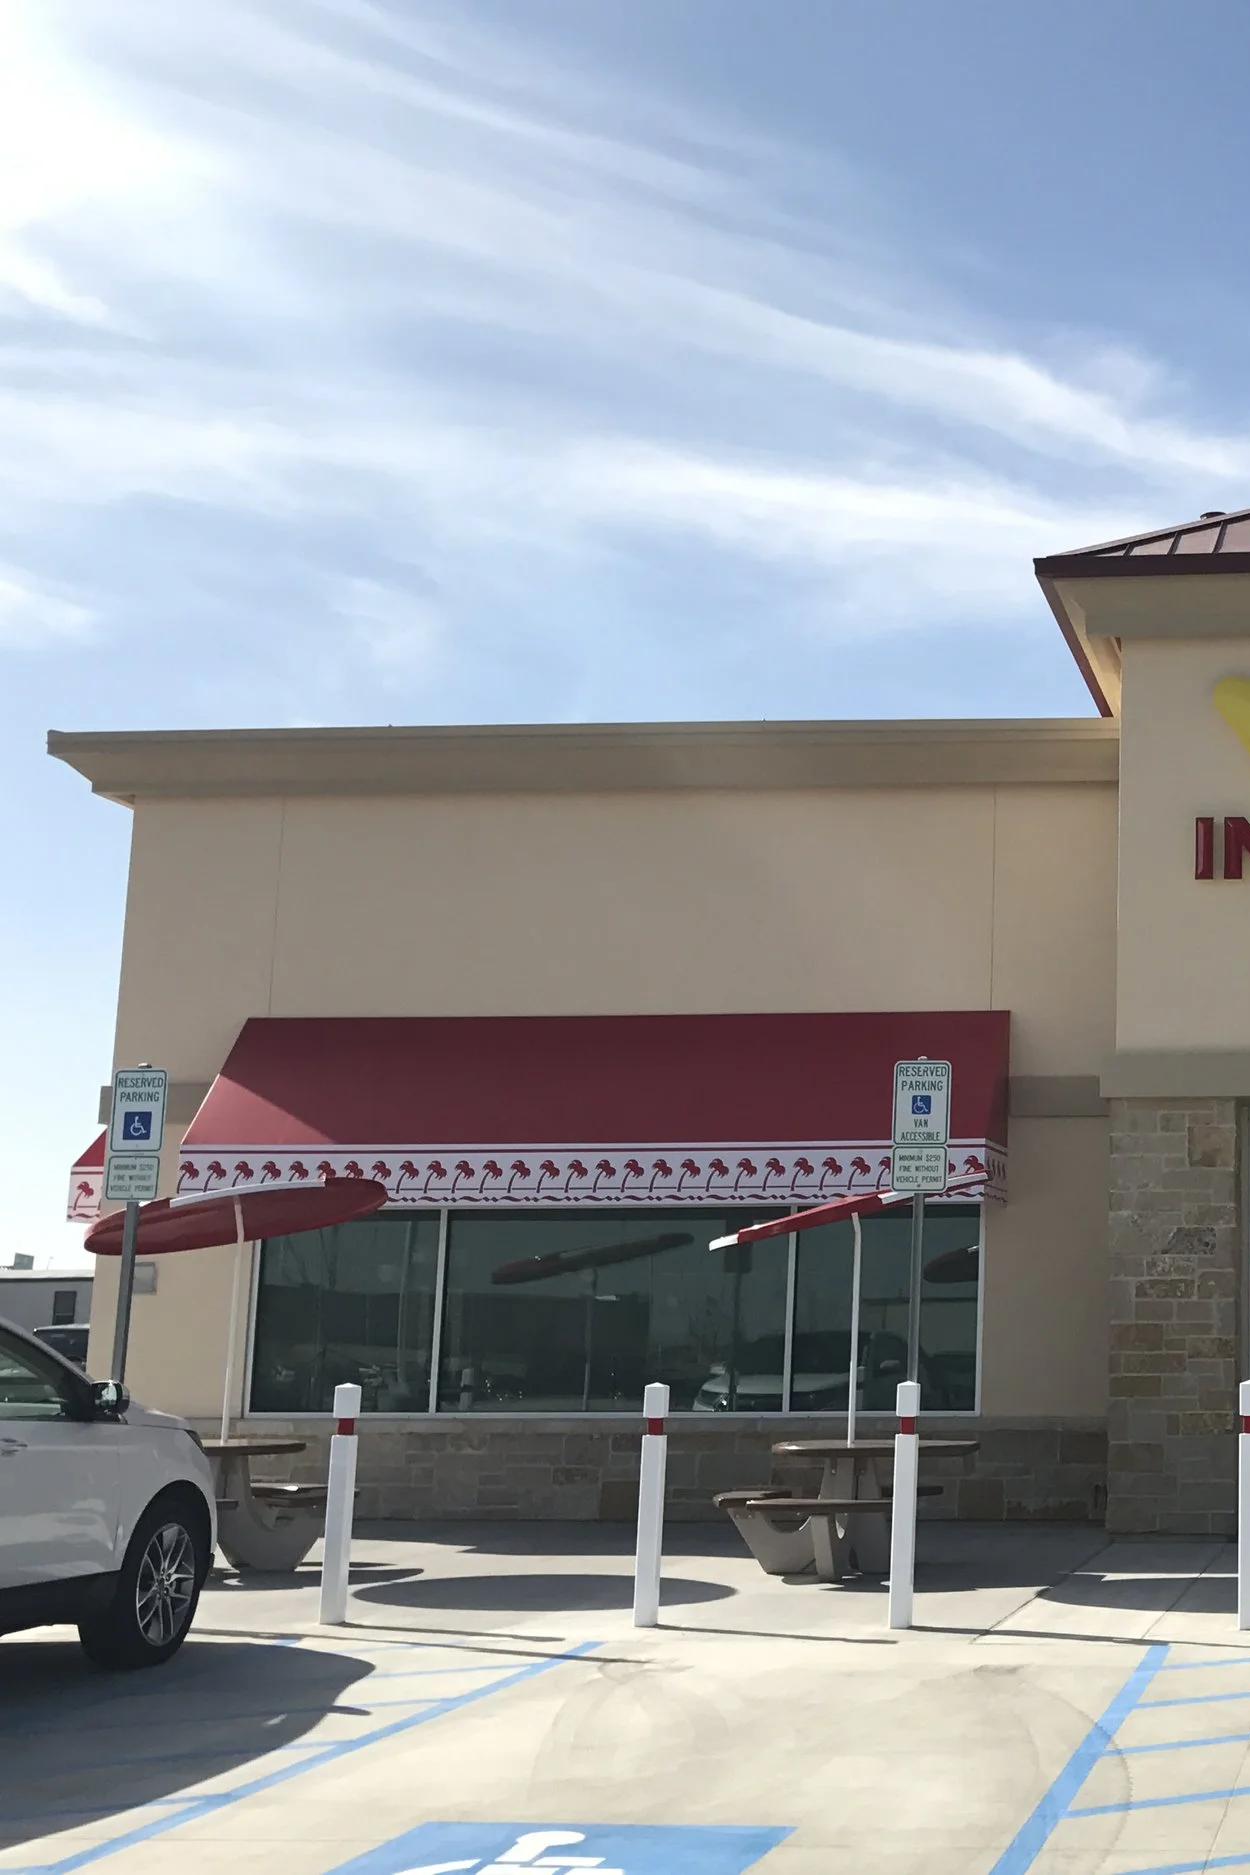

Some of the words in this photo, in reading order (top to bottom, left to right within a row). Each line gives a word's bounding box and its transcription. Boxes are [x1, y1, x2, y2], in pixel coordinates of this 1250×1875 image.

[898, 1066, 947, 1077] RESERVED
[118, 1076, 164, 1089] RESERVED
[901, 1080, 943, 1092] PARKING
[119, 1091, 160, 1103] PARKING
[913, 1118, 928, 1128] VAN
[900, 1131, 940, 1142] ACCESSIBLE
[898, 1154, 922, 1162] MINIMUM
[925, 1154, 941, 1162] $250
[899, 1165, 912, 1173] FINE
[914, 1165, 939, 1173] WITHOUT
[896, 1175, 918, 1183] VEHICLE
[921, 1175, 942, 1183] PERMIT
